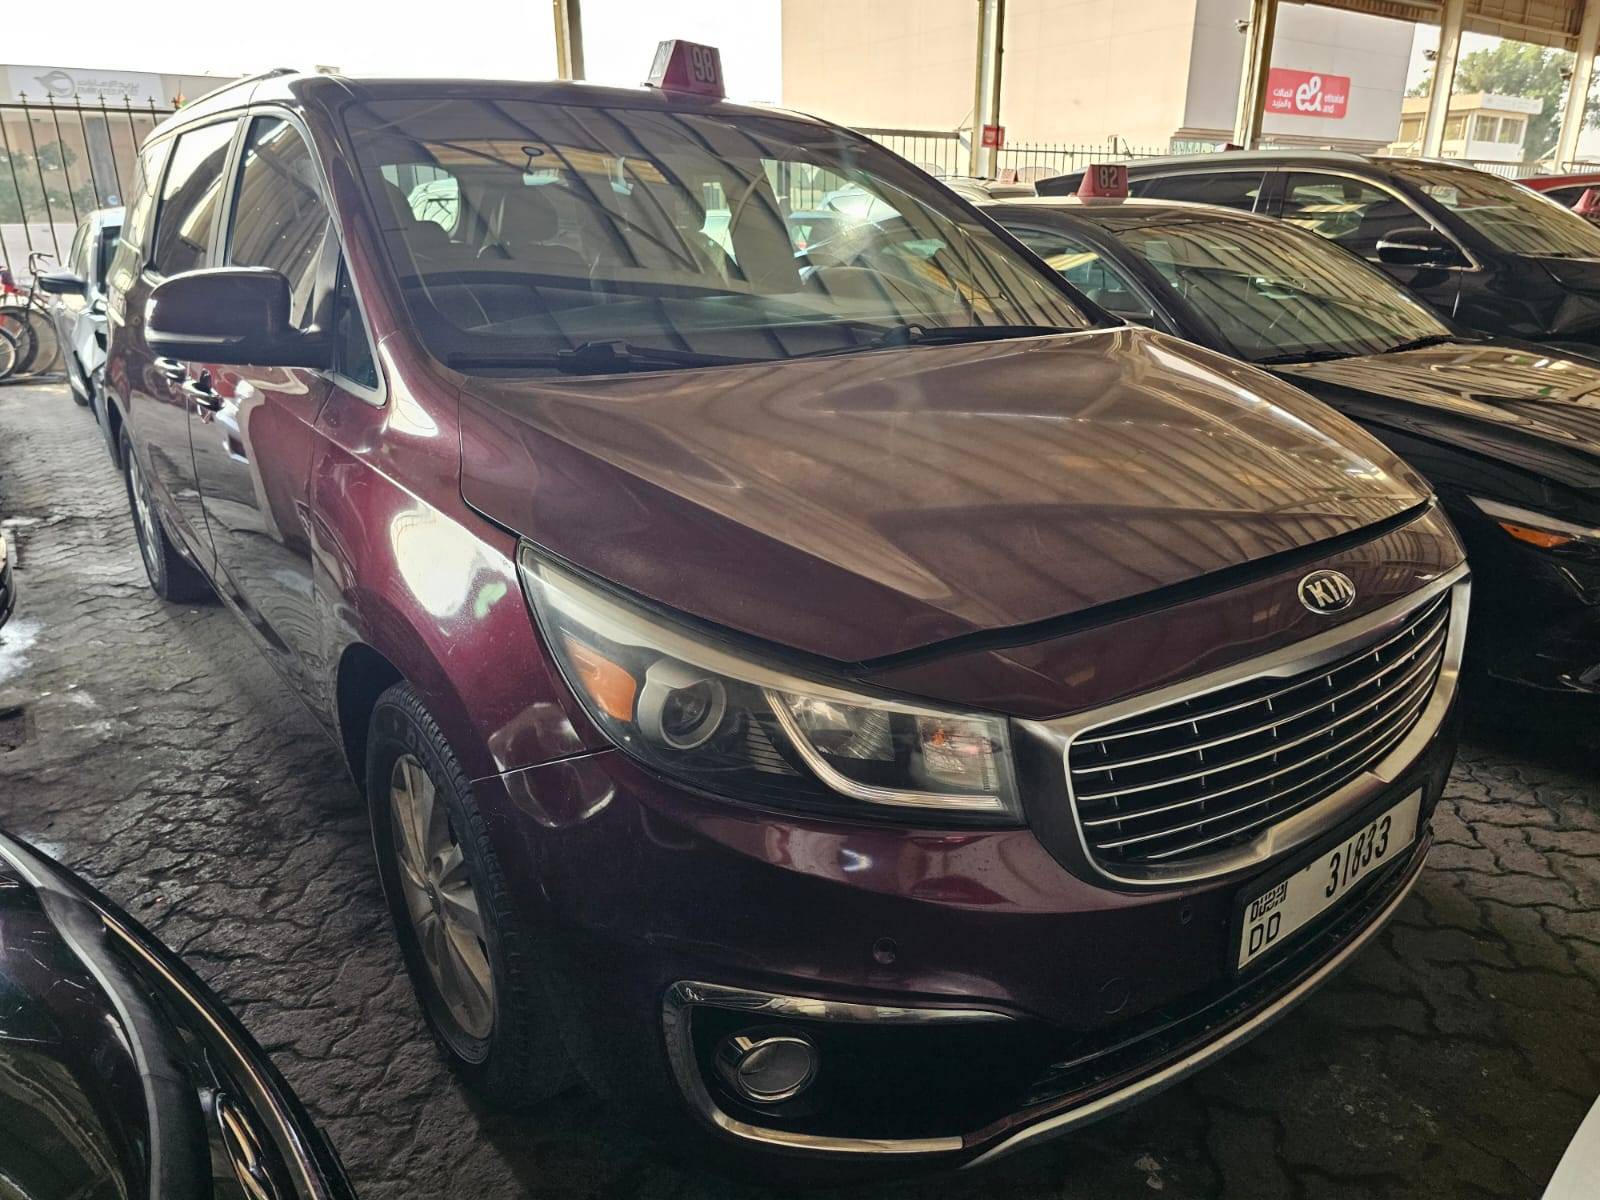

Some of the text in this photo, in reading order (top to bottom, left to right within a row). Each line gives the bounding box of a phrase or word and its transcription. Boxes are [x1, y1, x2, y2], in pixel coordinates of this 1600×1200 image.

[692, 46, 716, 82] 98
[1100, 166, 1119, 189] 82
[1305, 574, 1353, 608] KIA
[1325, 815, 1393, 898] 31833
[1248, 911, 1282, 957] DD
